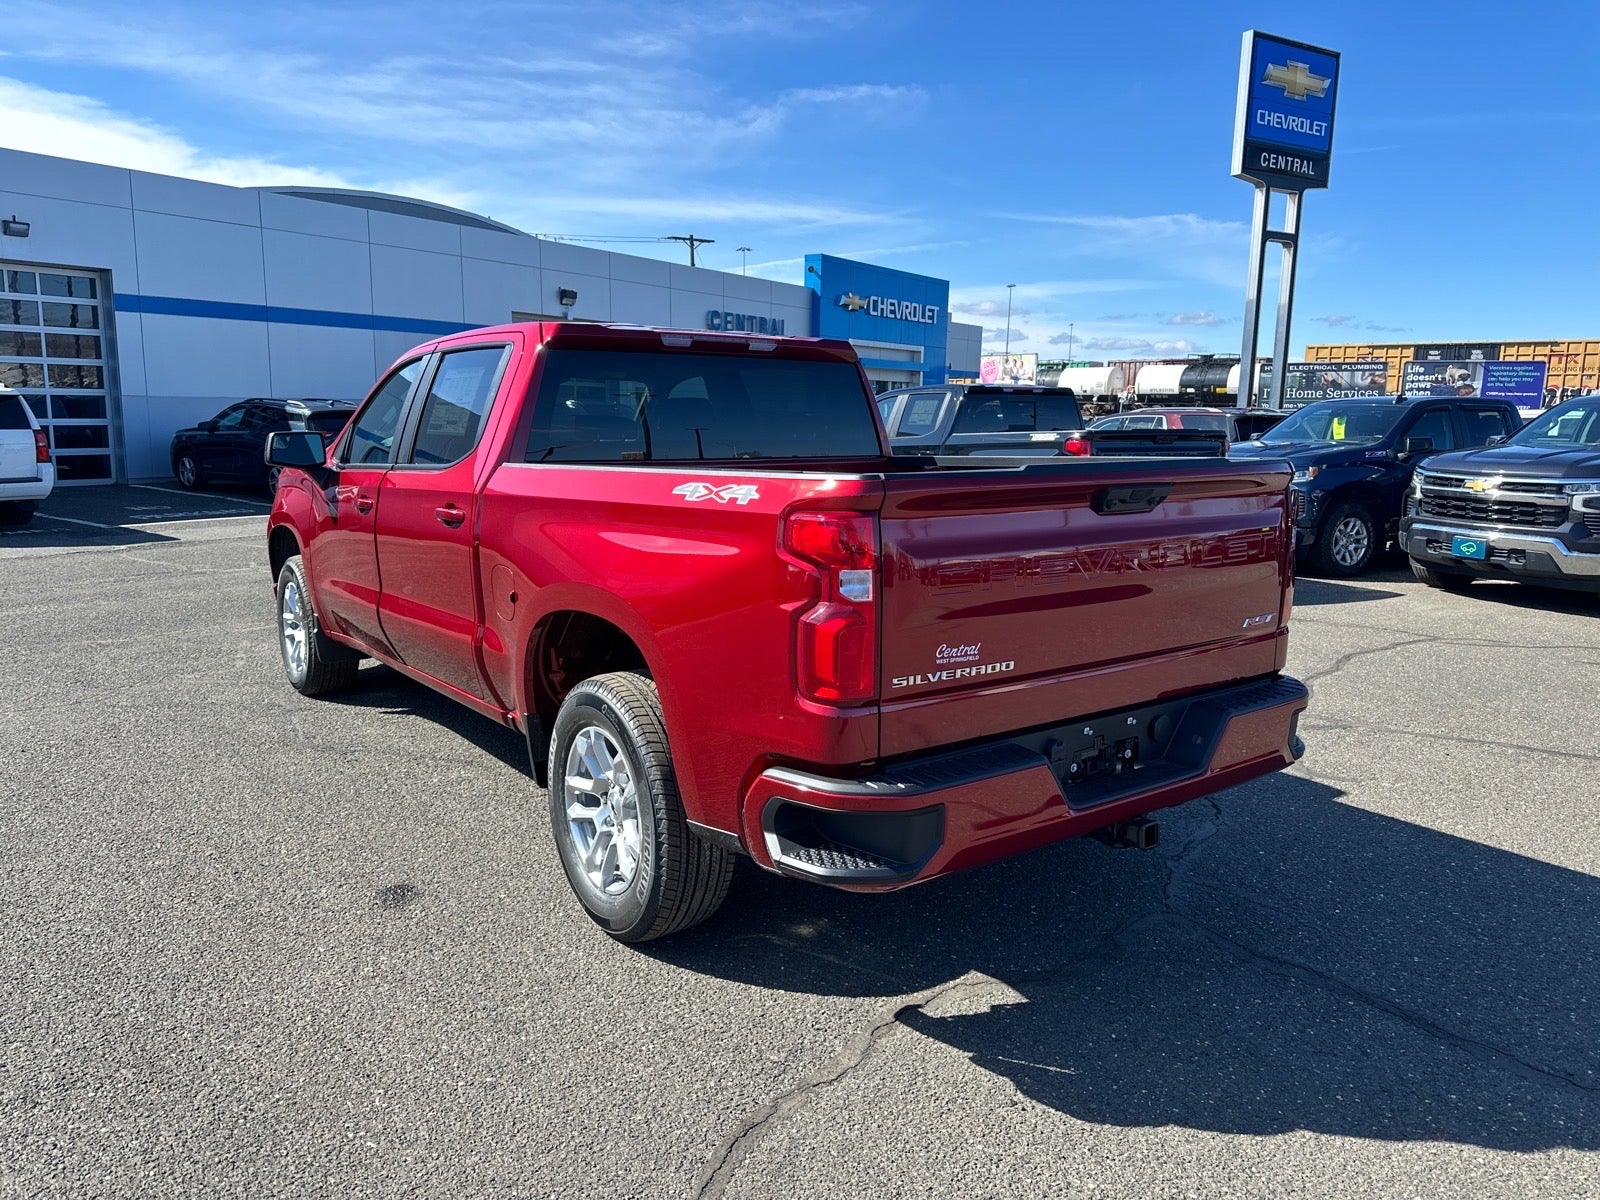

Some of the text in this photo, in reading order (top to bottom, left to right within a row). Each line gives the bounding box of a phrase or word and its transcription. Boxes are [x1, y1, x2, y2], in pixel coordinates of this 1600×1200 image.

[1257, 109, 1328, 136] CHEVROLET
[1260, 152, 1315, 175] CENTRAL
[869, 295, 940, 325] CHEVROLET
[1407, 365, 1425, 373] Life
[1286, 387, 1379, 399] Home Services
[1405, 382, 1432, 390] paws
[927, 531, 1276, 597] CHEVROLET
[1242, 612, 1277, 628] RST
[936, 642, 981, 658] Central
[950, 655, 980, 663] SPRINGFIELD
[892, 660, 1015, 689] SILVERADO
[638, 823, 651, 901] MICHELIN
